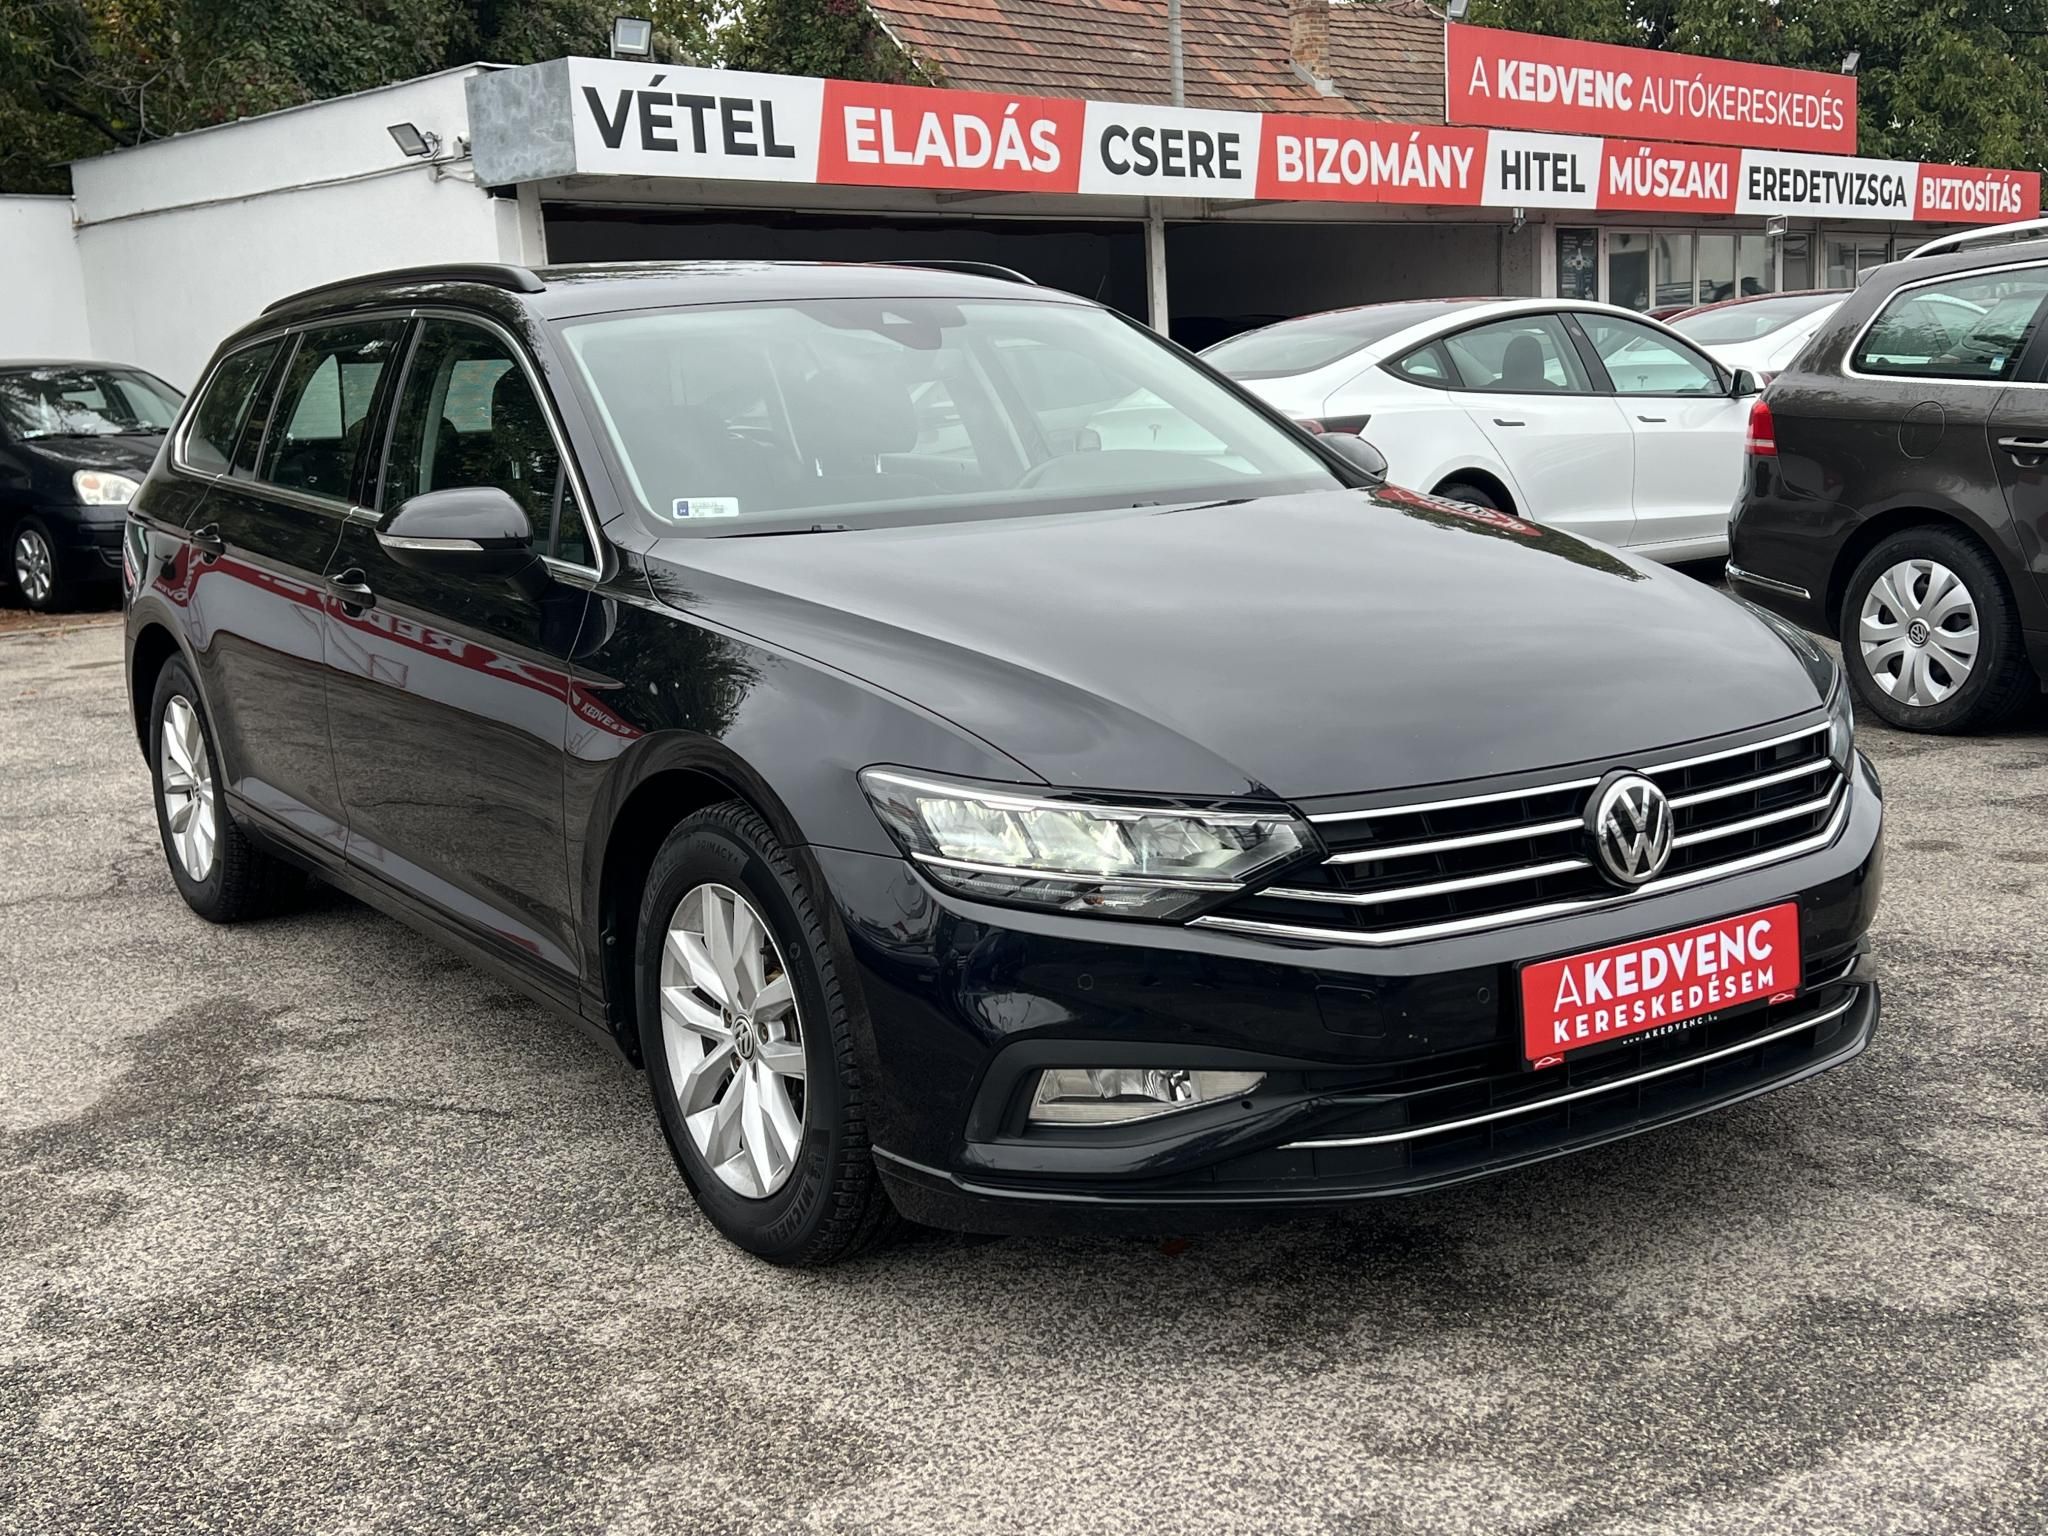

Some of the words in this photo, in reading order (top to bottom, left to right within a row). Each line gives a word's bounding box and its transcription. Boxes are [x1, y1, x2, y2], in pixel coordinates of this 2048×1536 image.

[582, 74, 796, 159] VÉTEL
[1468, 56, 1490, 97] A
[1497, 58, 1633, 112] KEDVENC
[1639, 72, 1844, 132] AUTÓKERESKEDÉS
[843, 102, 1061, 173] ELADÁS
[1100, 124, 1243, 180] CSERE
[1276, 131, 1474, 189] BIZOMÁNY
[1500, 149, 1586, 194] HITEL
[1608, 146, 1729, 200] MŰSZAKI
[1748, 165, 1908, 209] EREDETVIZSGA
[1922, 173, 2022, 214] BIZTOSÍTÁS
[1597, 776, 1674, 884] VW
[1553, 965, 1775, 1044] KERESKEDÉSEM
